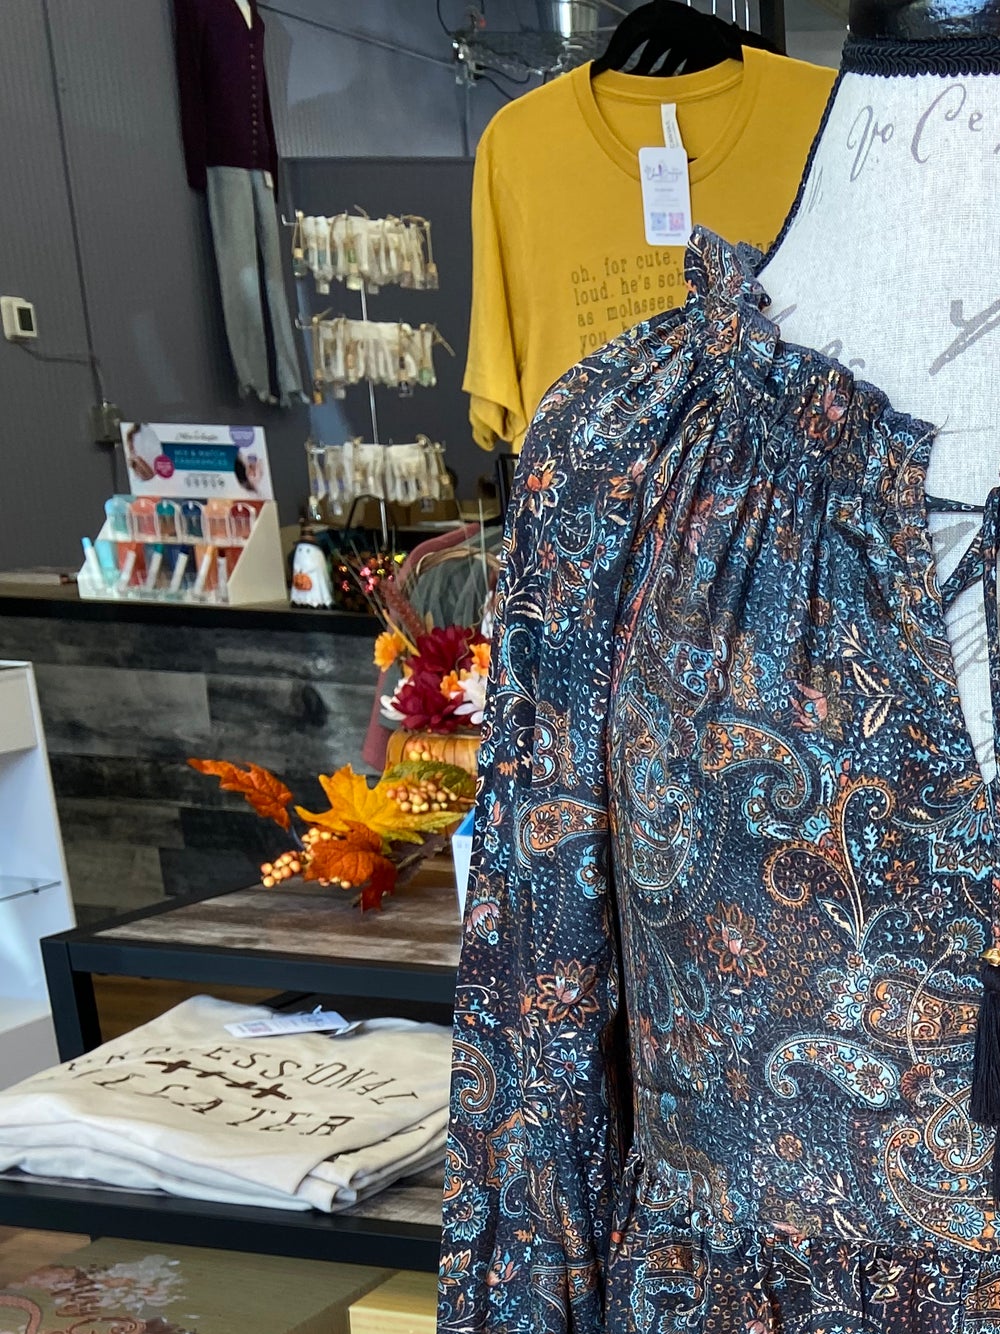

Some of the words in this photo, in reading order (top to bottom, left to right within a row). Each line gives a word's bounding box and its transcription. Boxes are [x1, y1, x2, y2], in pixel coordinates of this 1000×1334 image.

[571, 265, 597, 285] oh,
[604, 257, 627, 276] for
[636, 251, 678, 269] cute.
[573, 281, 615, 306] loud.
[620, 275, 652, 296] he's
[607, 295, 675, 321] molasses
